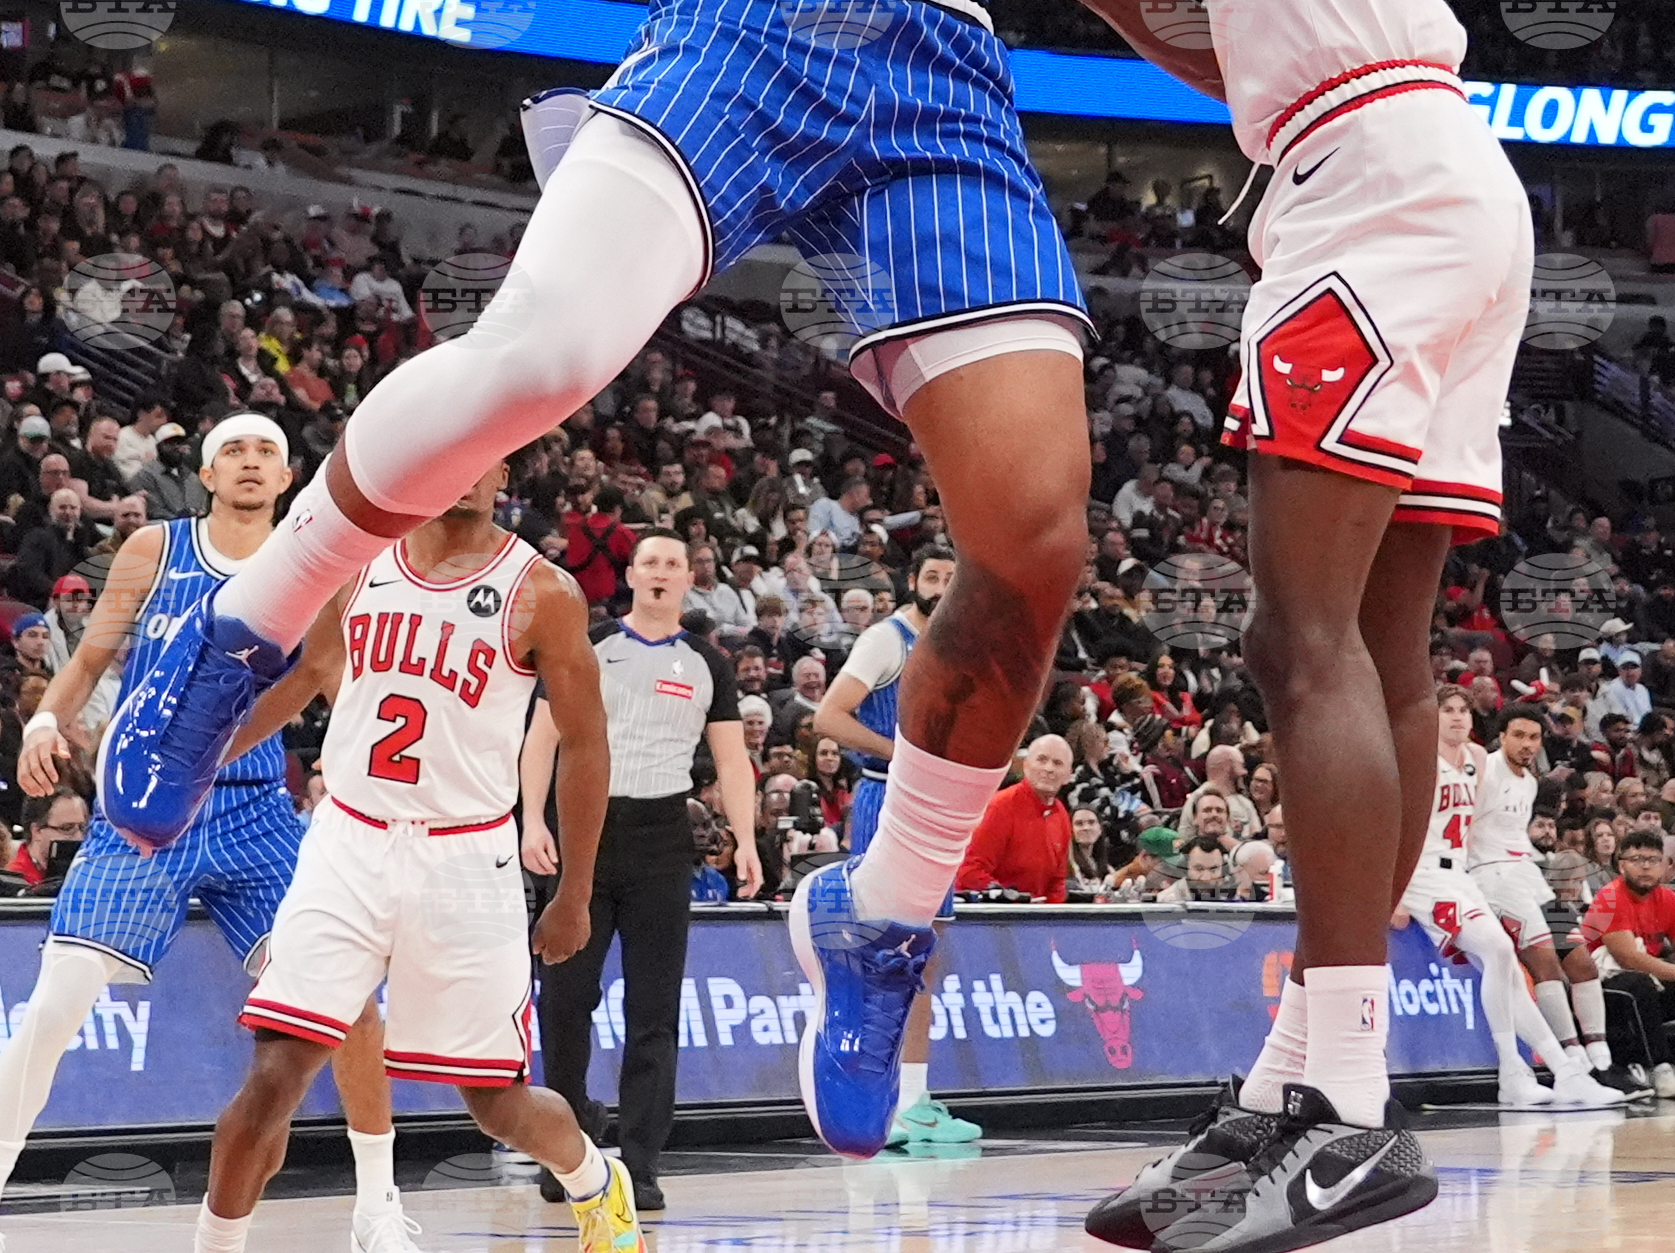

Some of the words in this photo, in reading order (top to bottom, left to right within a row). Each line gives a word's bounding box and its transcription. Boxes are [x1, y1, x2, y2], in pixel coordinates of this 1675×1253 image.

[349, 611, 497, 709] BULLS
[367, 692, 428, 786] 2
[971, 973, 1057, 1038] the
